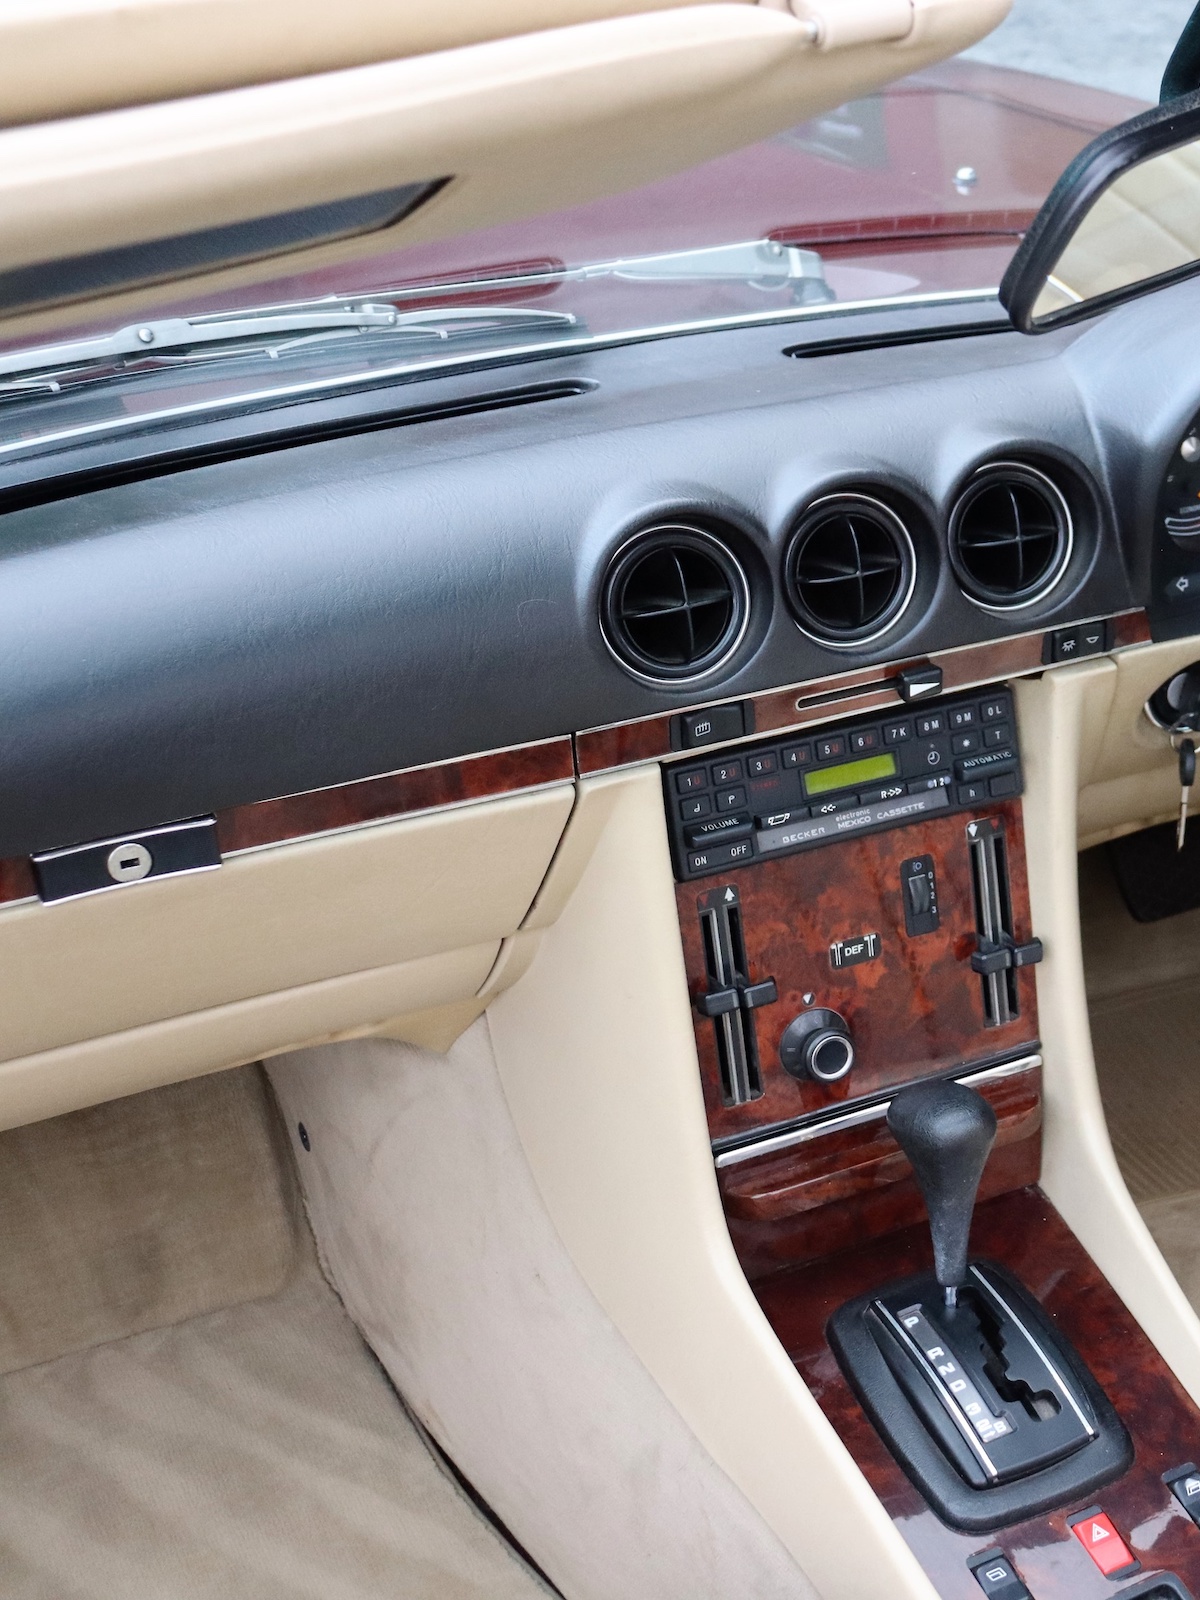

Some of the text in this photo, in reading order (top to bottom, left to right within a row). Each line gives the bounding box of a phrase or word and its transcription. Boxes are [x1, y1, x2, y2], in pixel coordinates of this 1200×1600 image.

[996, 705, 1002, 715] L
[956, 712, 972, 724] 9 M
[924, 720, 940, 731] 8 M
[891, 727, 907, 739] 7 K
[995, 730, 1001, 740] T
[858, 737, 864, 747] 6
[824, 745, 831, 755] 5
[791, 752, 797, 762] 4
[963, 751, 1012, 768] AUTOMATIC
[756, 761, 762, 771] 3
[720, 769, 727, 779] 2
[687, 777, 692, 786] 1
[835, 808, 870, 822] electronic
[701, 818, 740, 832] VOLUME
[782, 802, 926, 844] BECKER MEXICO CASSETTE
[730, 844, 747, 857] OFF
[694, 856, 708, 867] ON
[927, 871, 934, 879] 0
[930, 882, 934, 890] 1
[930, 892, 936, 900] 2
[931, 906, 937, 914] 3
[844, 943, 864, 957] DEF
[904, 1316, 919, 1329] P
[926, 1346, 944, 1360] R
[938, 1362, 956, 1376] N
[949, 1379, 967, 1393] D
[965, 1402, 982, 1416] 3
